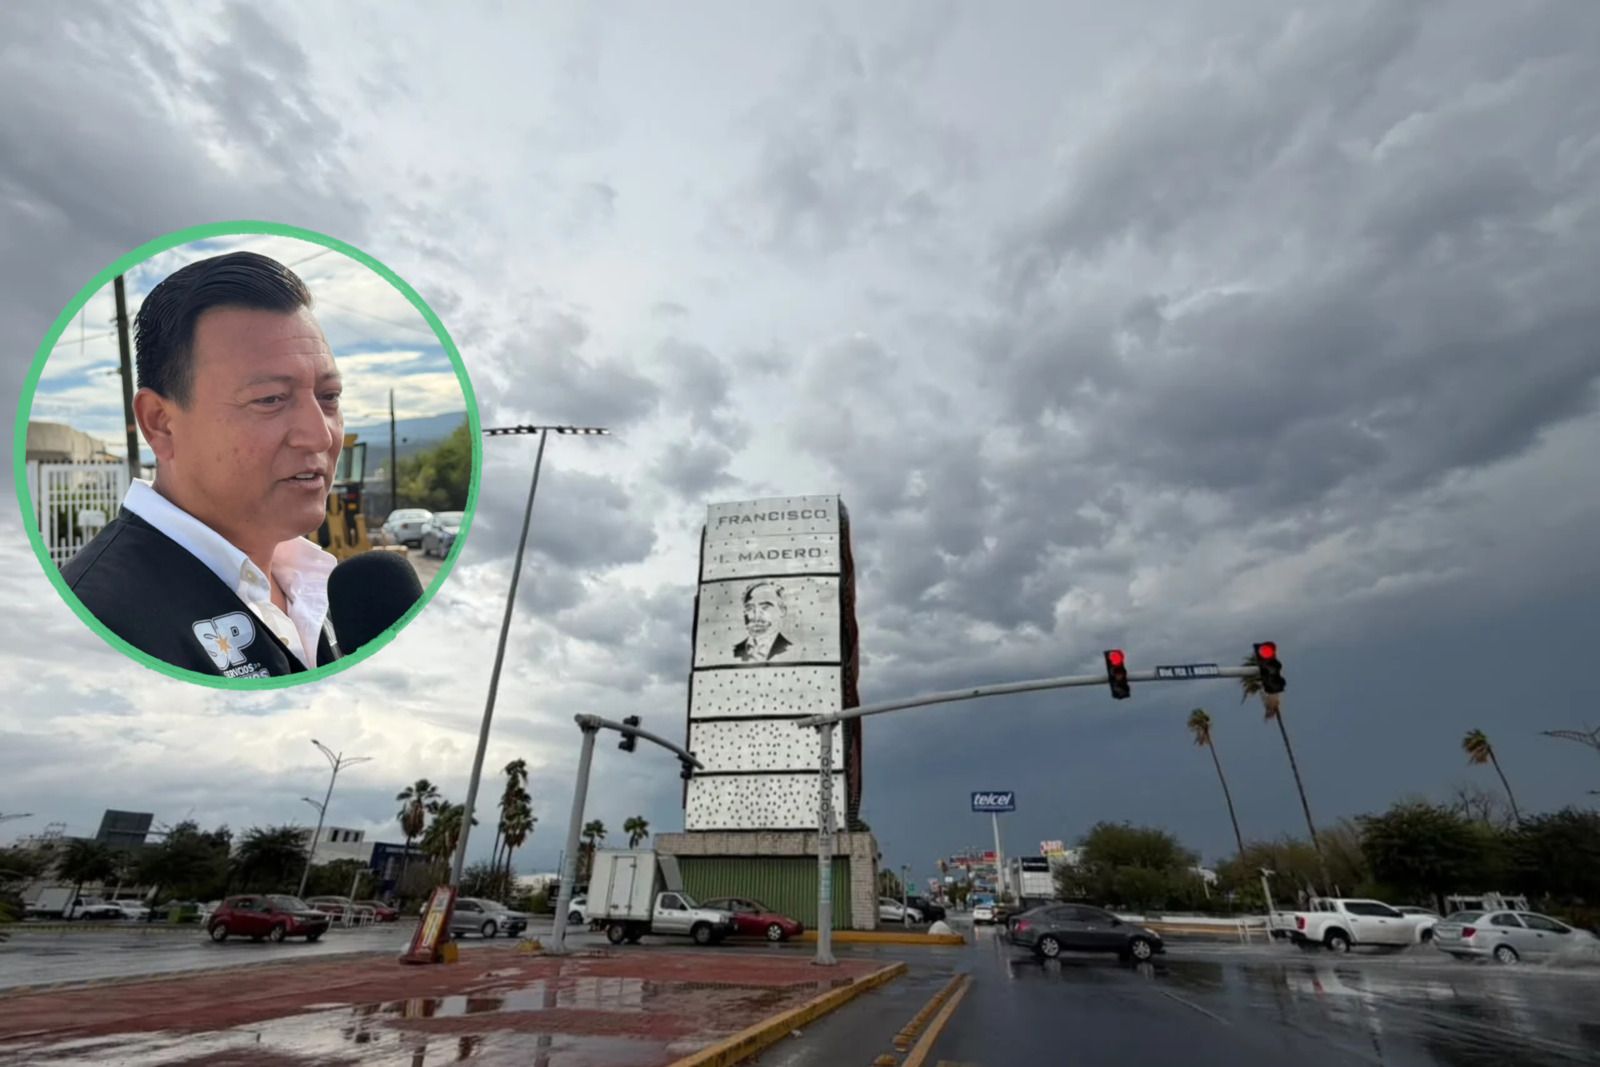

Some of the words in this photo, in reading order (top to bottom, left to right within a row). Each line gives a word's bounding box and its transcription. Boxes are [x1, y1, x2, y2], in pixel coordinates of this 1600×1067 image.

[718, 509, 827, 526] FRANCISCO
[738, 547, 822, 562] MADERO
[974, 793, 1012, 806] telcel
